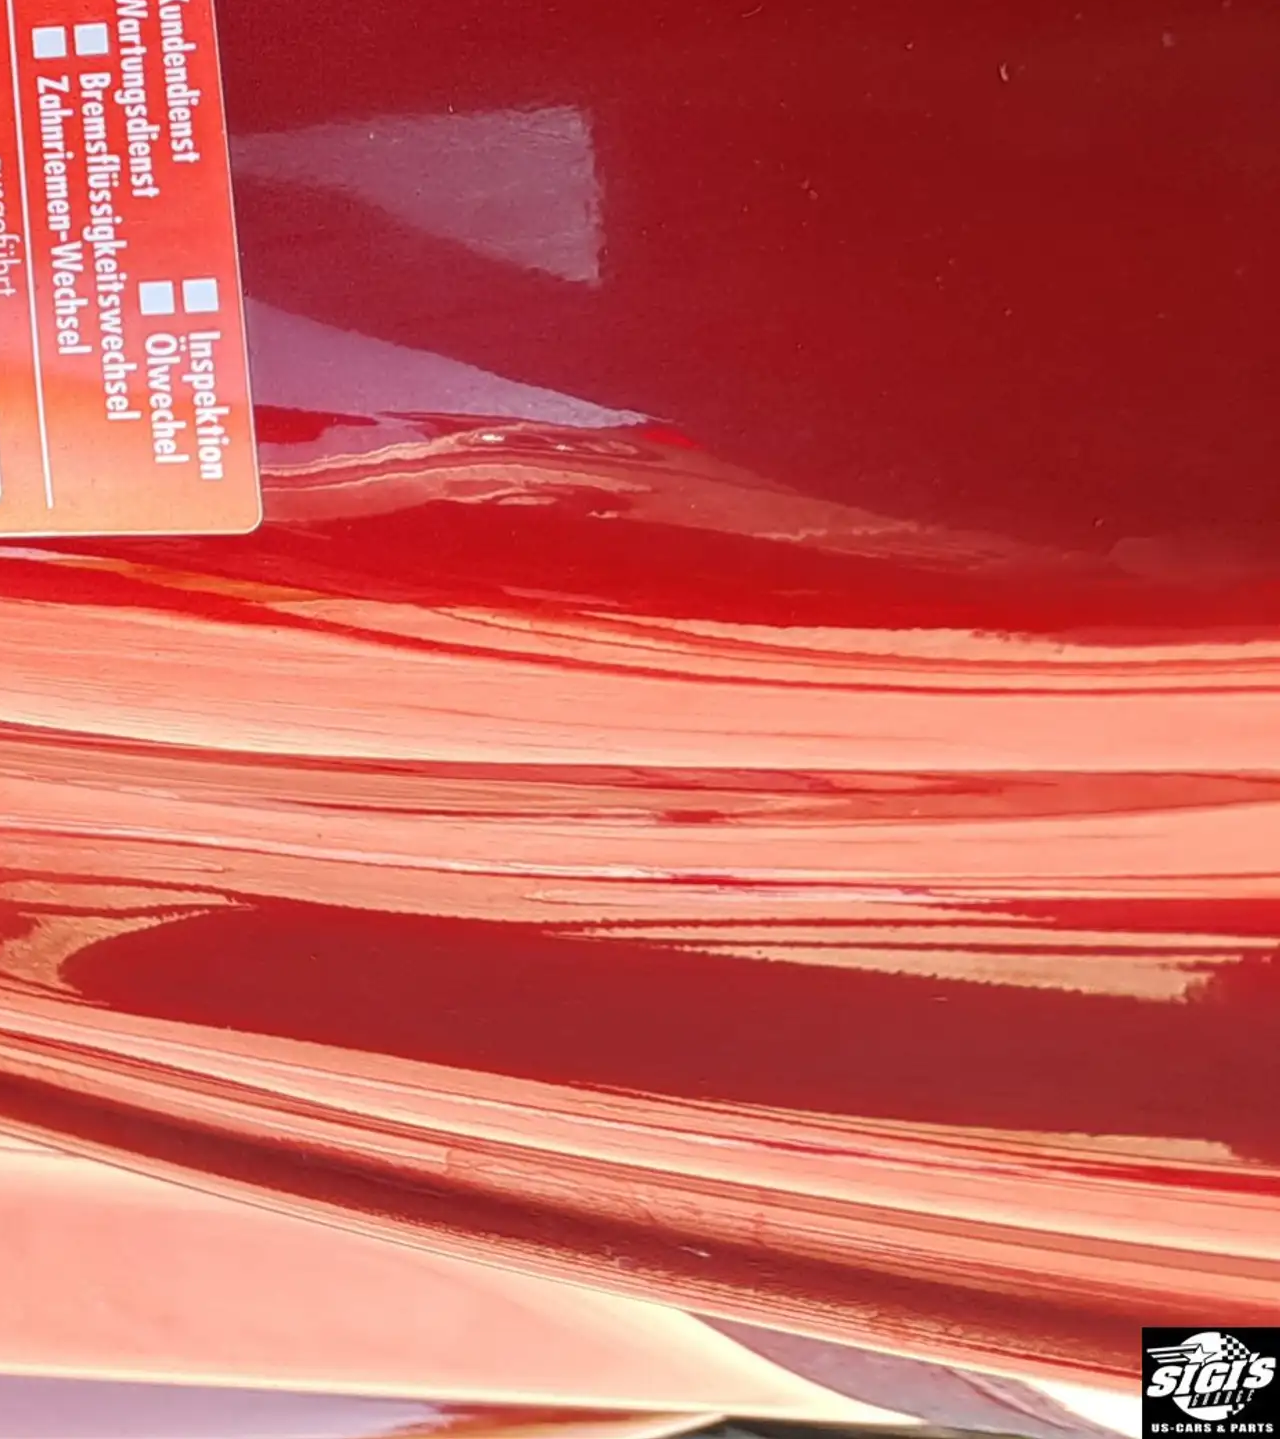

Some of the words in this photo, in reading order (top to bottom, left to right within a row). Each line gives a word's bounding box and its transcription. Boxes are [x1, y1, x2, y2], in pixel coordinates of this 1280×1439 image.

[35, 75, 92, 356] Zahnriemen-Wechsel
[77, 71, 142, 423] Bremsflüssigkeitswechsel
[145, 332, 191, 464] Ölwechel
[182, 330, 231, 480] Inspektion
